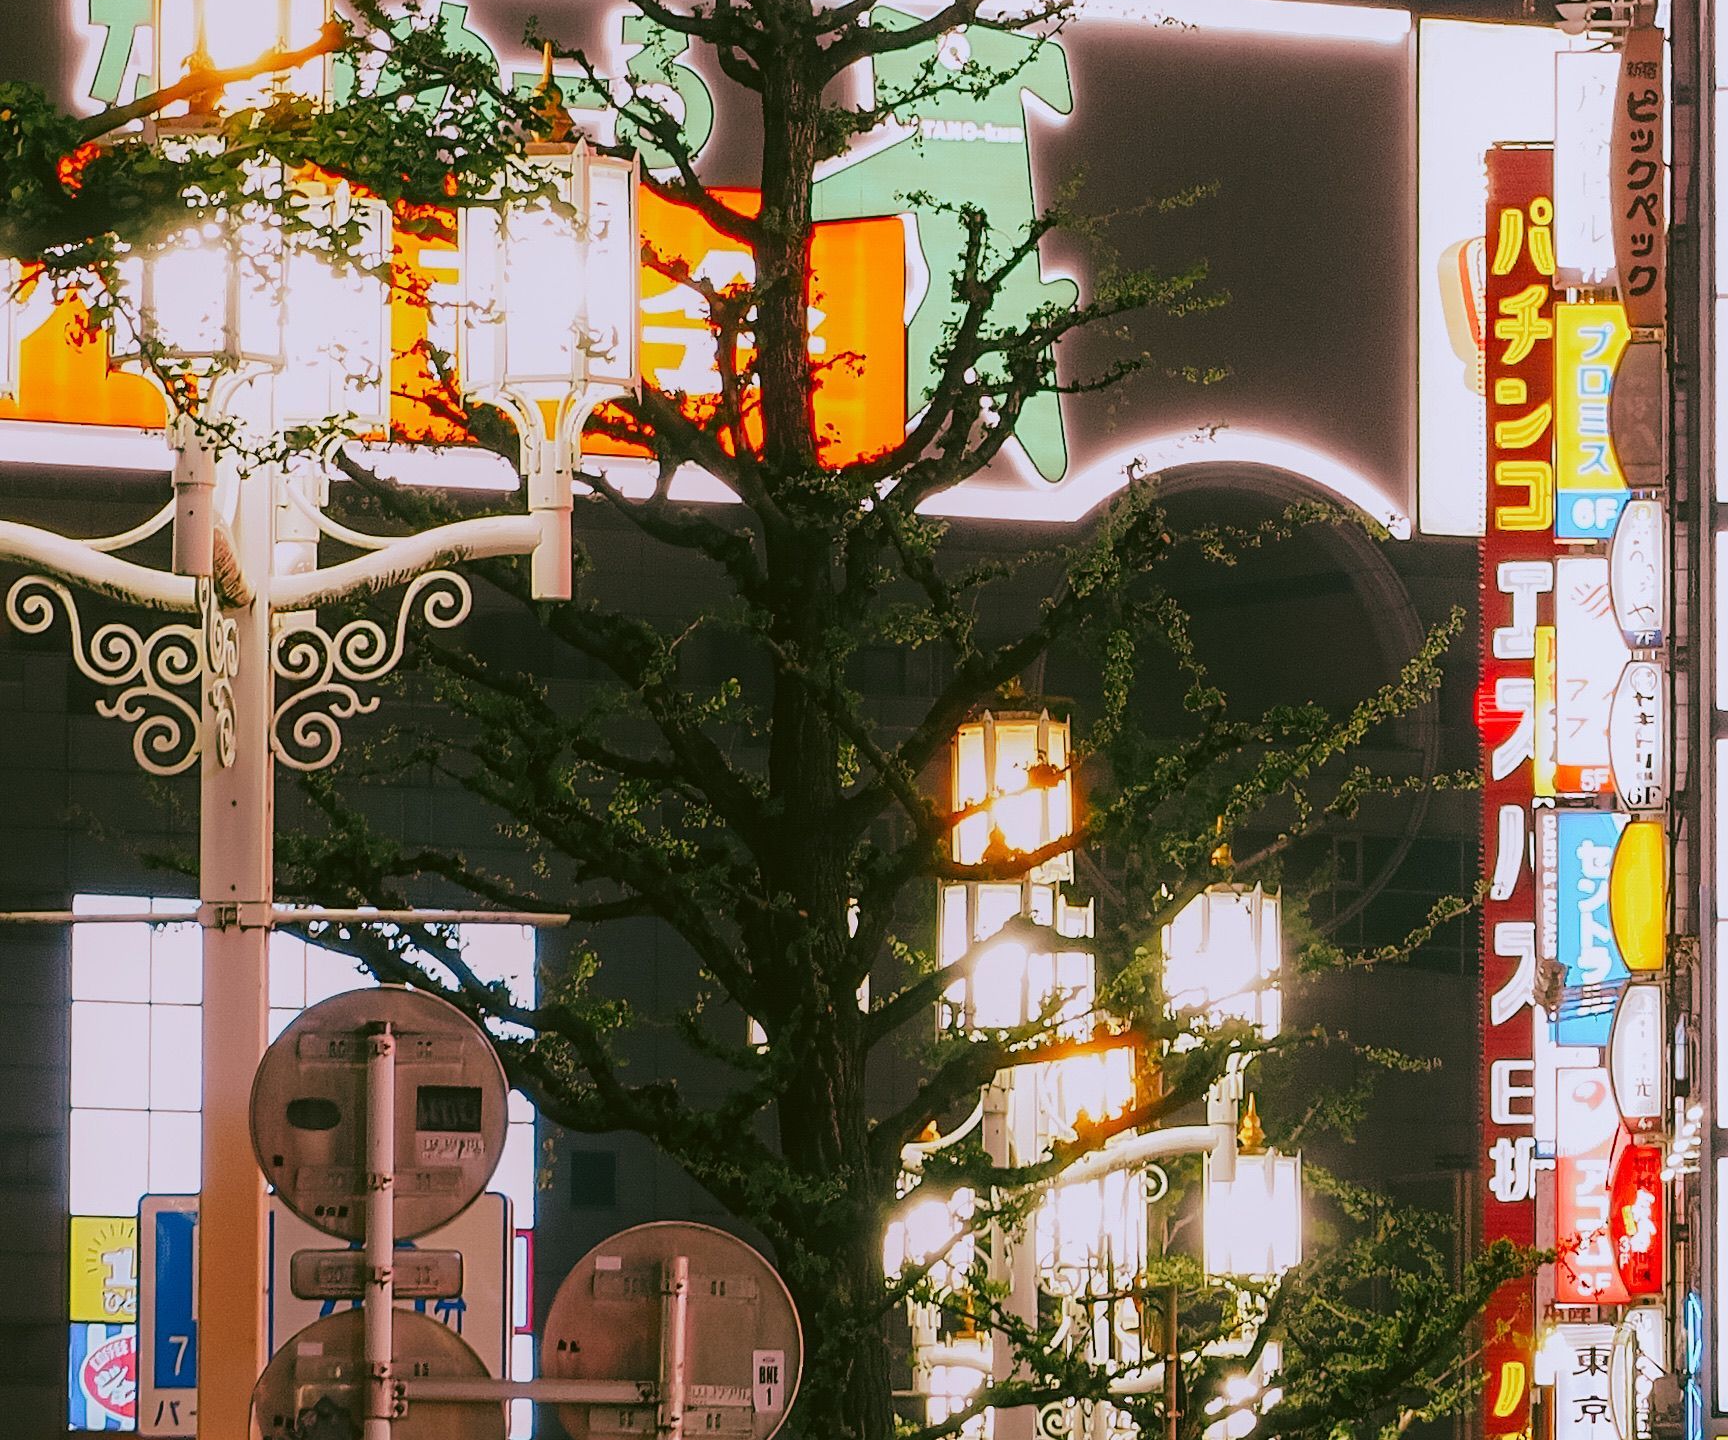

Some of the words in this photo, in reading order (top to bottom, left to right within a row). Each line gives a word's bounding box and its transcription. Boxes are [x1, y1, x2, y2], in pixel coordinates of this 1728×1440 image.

[1491, 196, 1556, 531] パチンコ
[1577, 323, 1615, 475] プロミス
[1571, 498, 1620, 530] 6F
[1634, 631, 1655, 646] 7F
